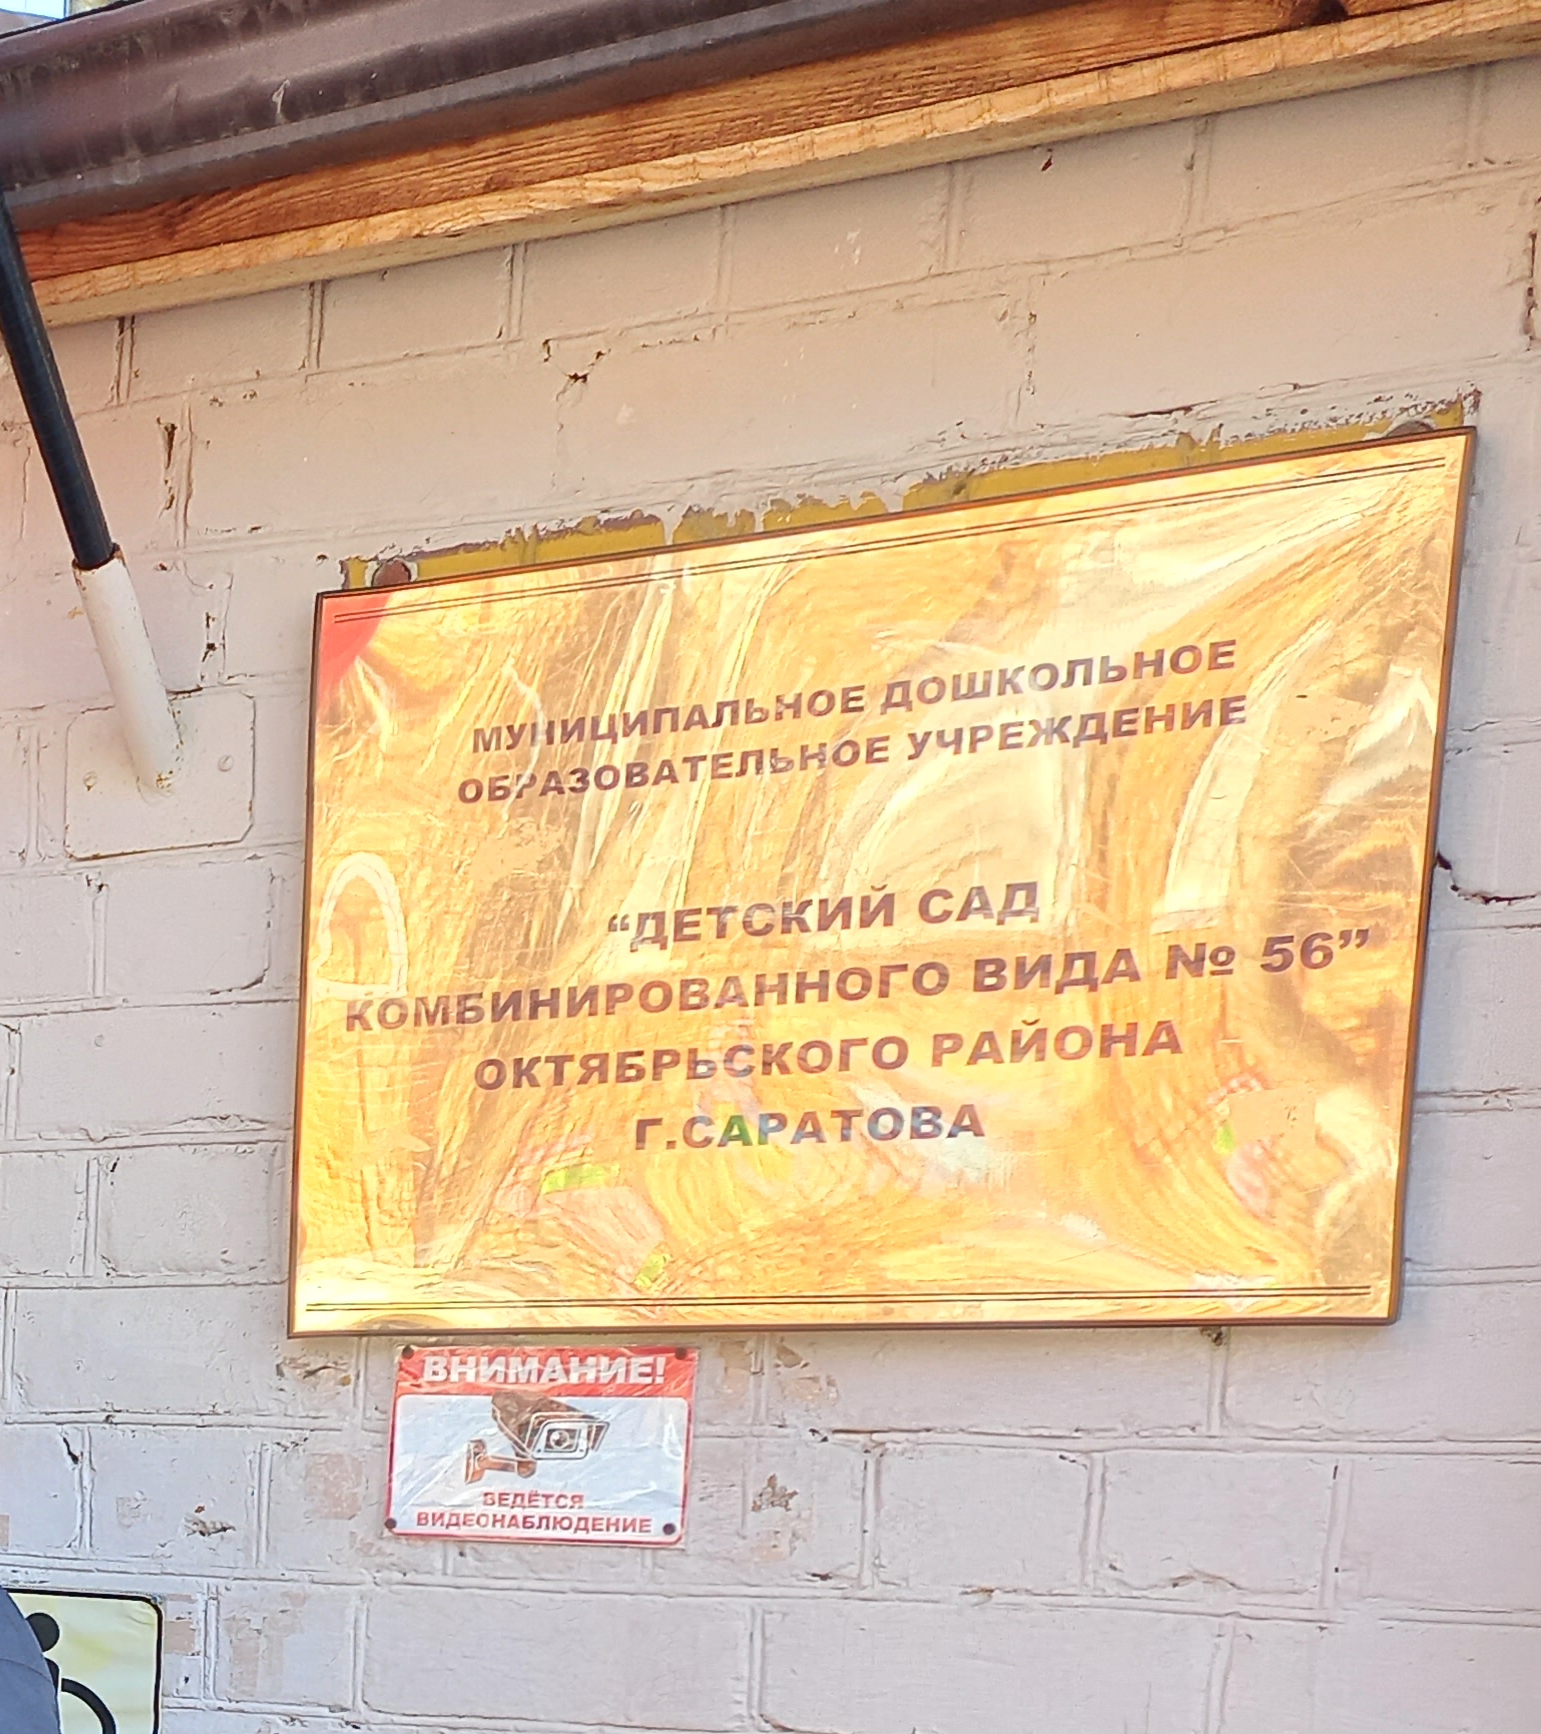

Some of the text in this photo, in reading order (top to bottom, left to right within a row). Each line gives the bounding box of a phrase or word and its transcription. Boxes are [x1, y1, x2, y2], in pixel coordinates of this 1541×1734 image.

[472, 639, 1237, 754] МУНИЦИПАЛЬНОЕ ДОШКОЛЬНОЕ
[457, 694, 1248, 804] ОБРАЗОВАТЕЛЬНОЕ УЧРЕЖДЕНИЕ
[917, 881, 1040, 926] САД
[345, 961, 950, 1032] КОМБИНИРОВАННОГО
[972, 948, 1143, 995] ВИДА
[1165, 942, 1237, 981] №
[474, 1018, 1184, 1092] ОКТЯБРЬСКОГО РАЙОНА
[635, 1104, 985, 1151] Г.САРАТОВА
[423, 1355, 667, 1385] ВНИМАНИЕ!
[416, 1510, 653, 1535] ВИДЕОНАБЛЮДЕНИЕ
[483, 1489, 585, 1510] ВЕДЁТСЯ
